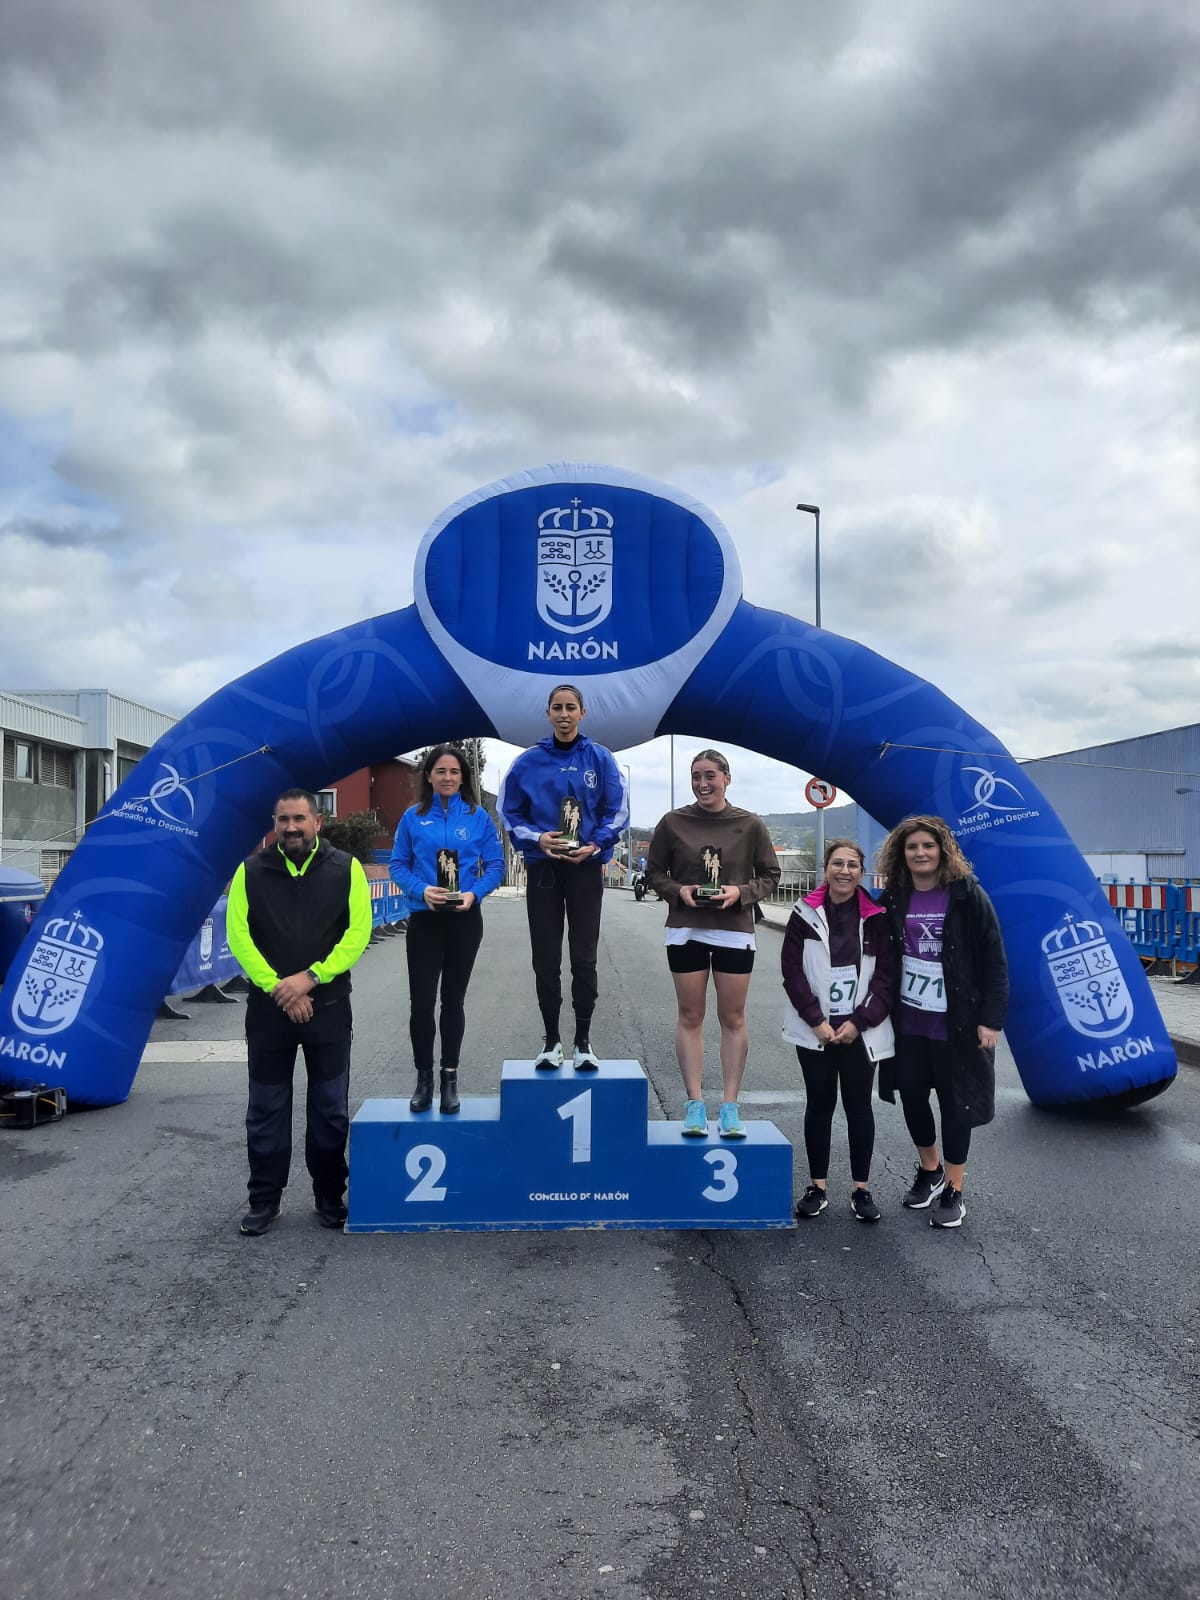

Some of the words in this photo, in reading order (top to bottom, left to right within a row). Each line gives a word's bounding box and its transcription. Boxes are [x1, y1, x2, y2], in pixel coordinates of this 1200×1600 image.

[528, 636, 619, 661] NARÓN
[145, 816, 156, 825] de
[158, 820, 199, 837] Deportes
[950, 821, 993, 837] Padroado
[993, 817, 1005, 826] de
[1005, 810, 1040, 823] Deportes
[958, 811, 990, 826] Narón
[905, 971, 943, 999] 771
[1077, 1036, 1155, 1073] NARÓN
[556, 1088, 592, 1163] 1
[404, 1144, 448, 1202] 2
[701, 1149, 740, 1203] 3
[529, 1192, 578, 1201] CONCELLO
[594, 1190, 630, 1201] NARÓN
